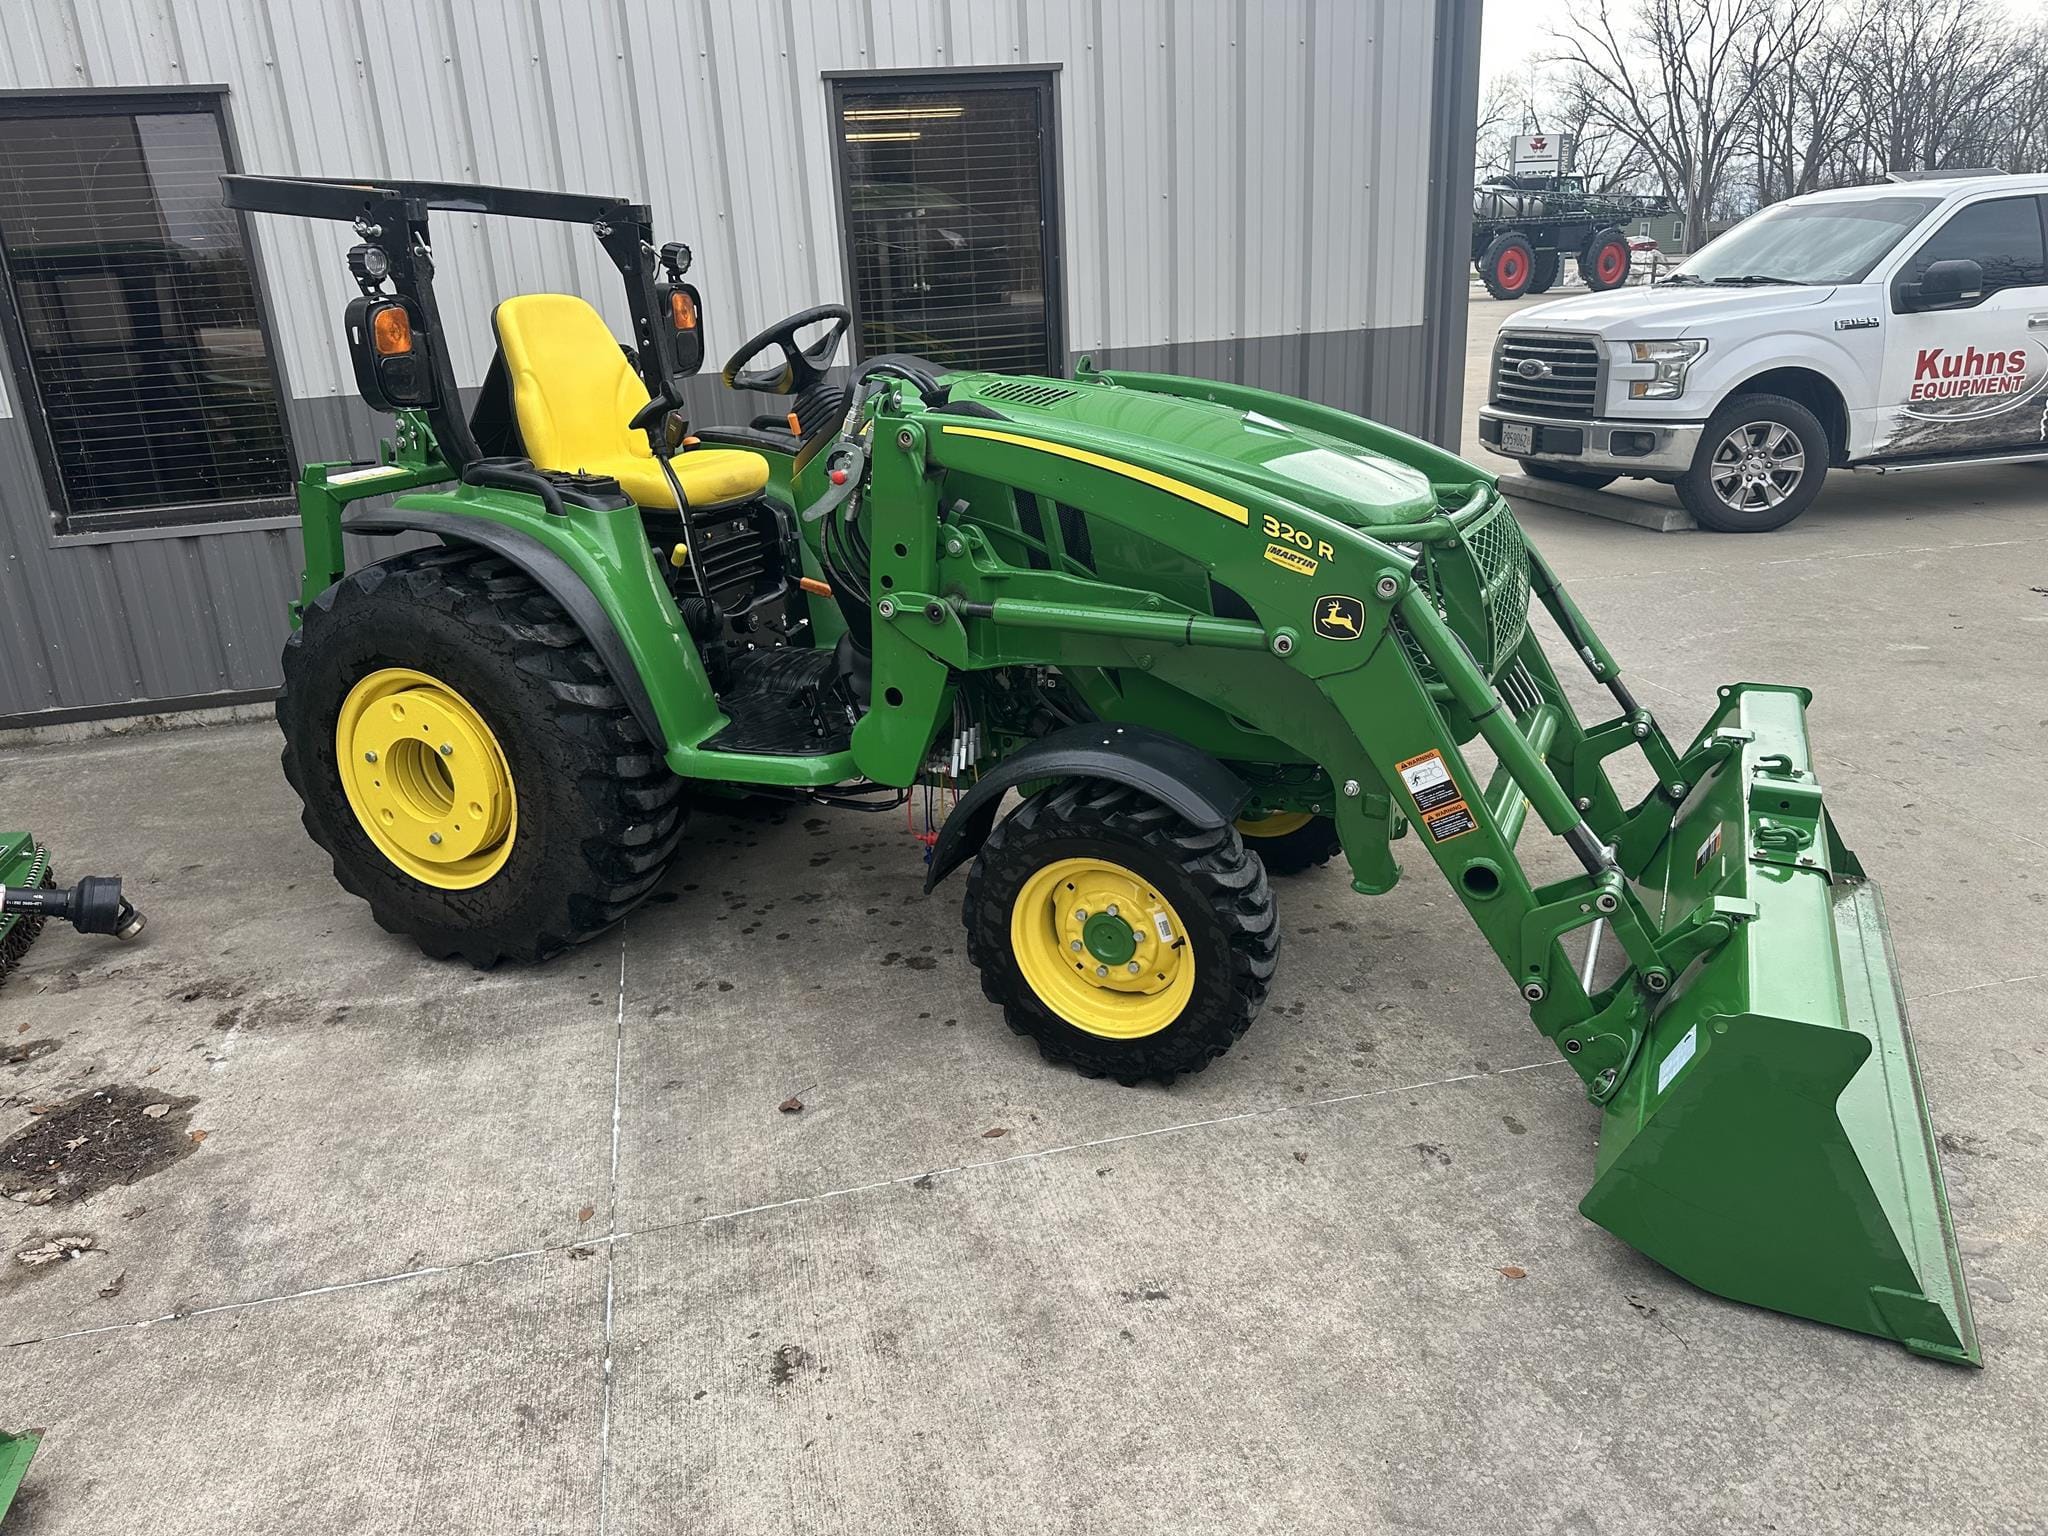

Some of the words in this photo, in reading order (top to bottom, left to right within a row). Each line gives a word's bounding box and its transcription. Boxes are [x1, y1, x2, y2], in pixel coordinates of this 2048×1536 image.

[1914, 346, 2026, 380] Kuhns
[1910, 375, 2026, 400] EQUIPMENT
[1263, 514, 1313, 551] 320
[1318, 539, 1335, 564] R
[1268, 546, 1316, 569] MARTIN
[1407, 752, 1434, 767] WARNING
[1435, 804, 1463, 818] WARNING
